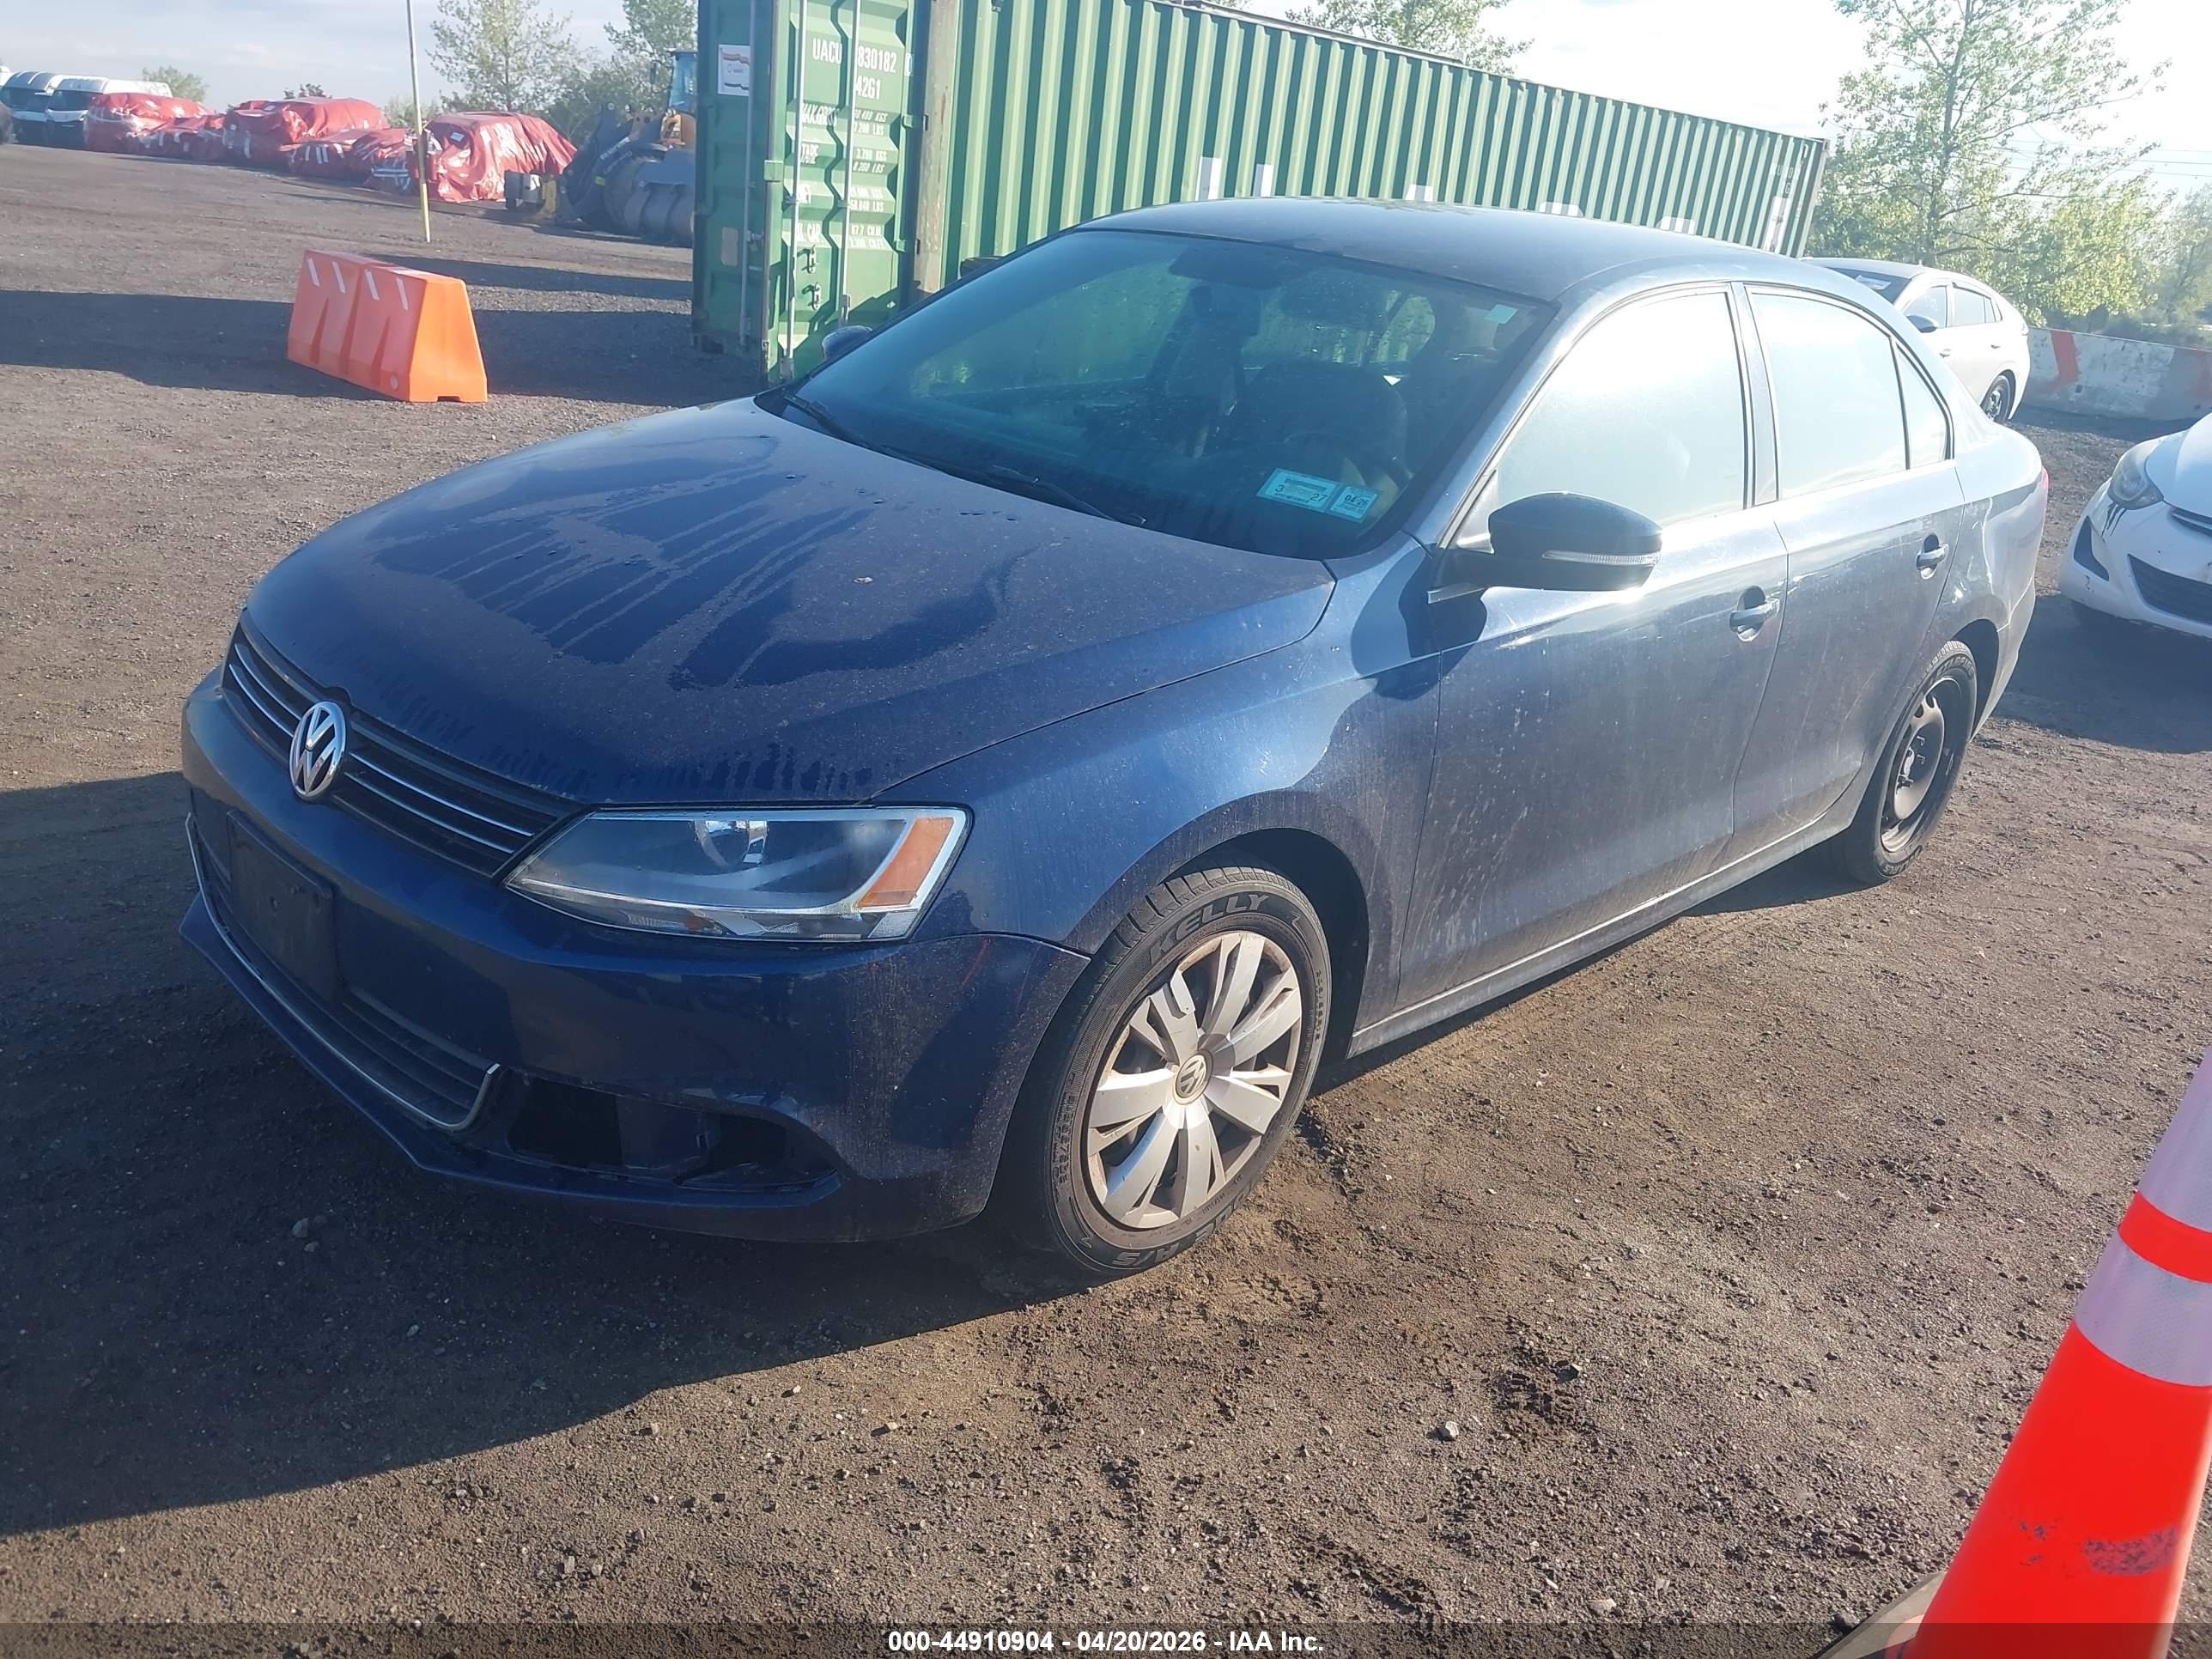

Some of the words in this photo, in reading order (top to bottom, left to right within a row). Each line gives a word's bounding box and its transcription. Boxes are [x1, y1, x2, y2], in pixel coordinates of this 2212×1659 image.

[812, 38, 842, 64] UACU
[857, 46, 897, 74] 830182
[854, 75, 881, 100] 42G1
[1274, 483, 1285, 493] 3
[1310, 493, 1328, 503] 27
[1149, 894, 1270, 967] KELLY
